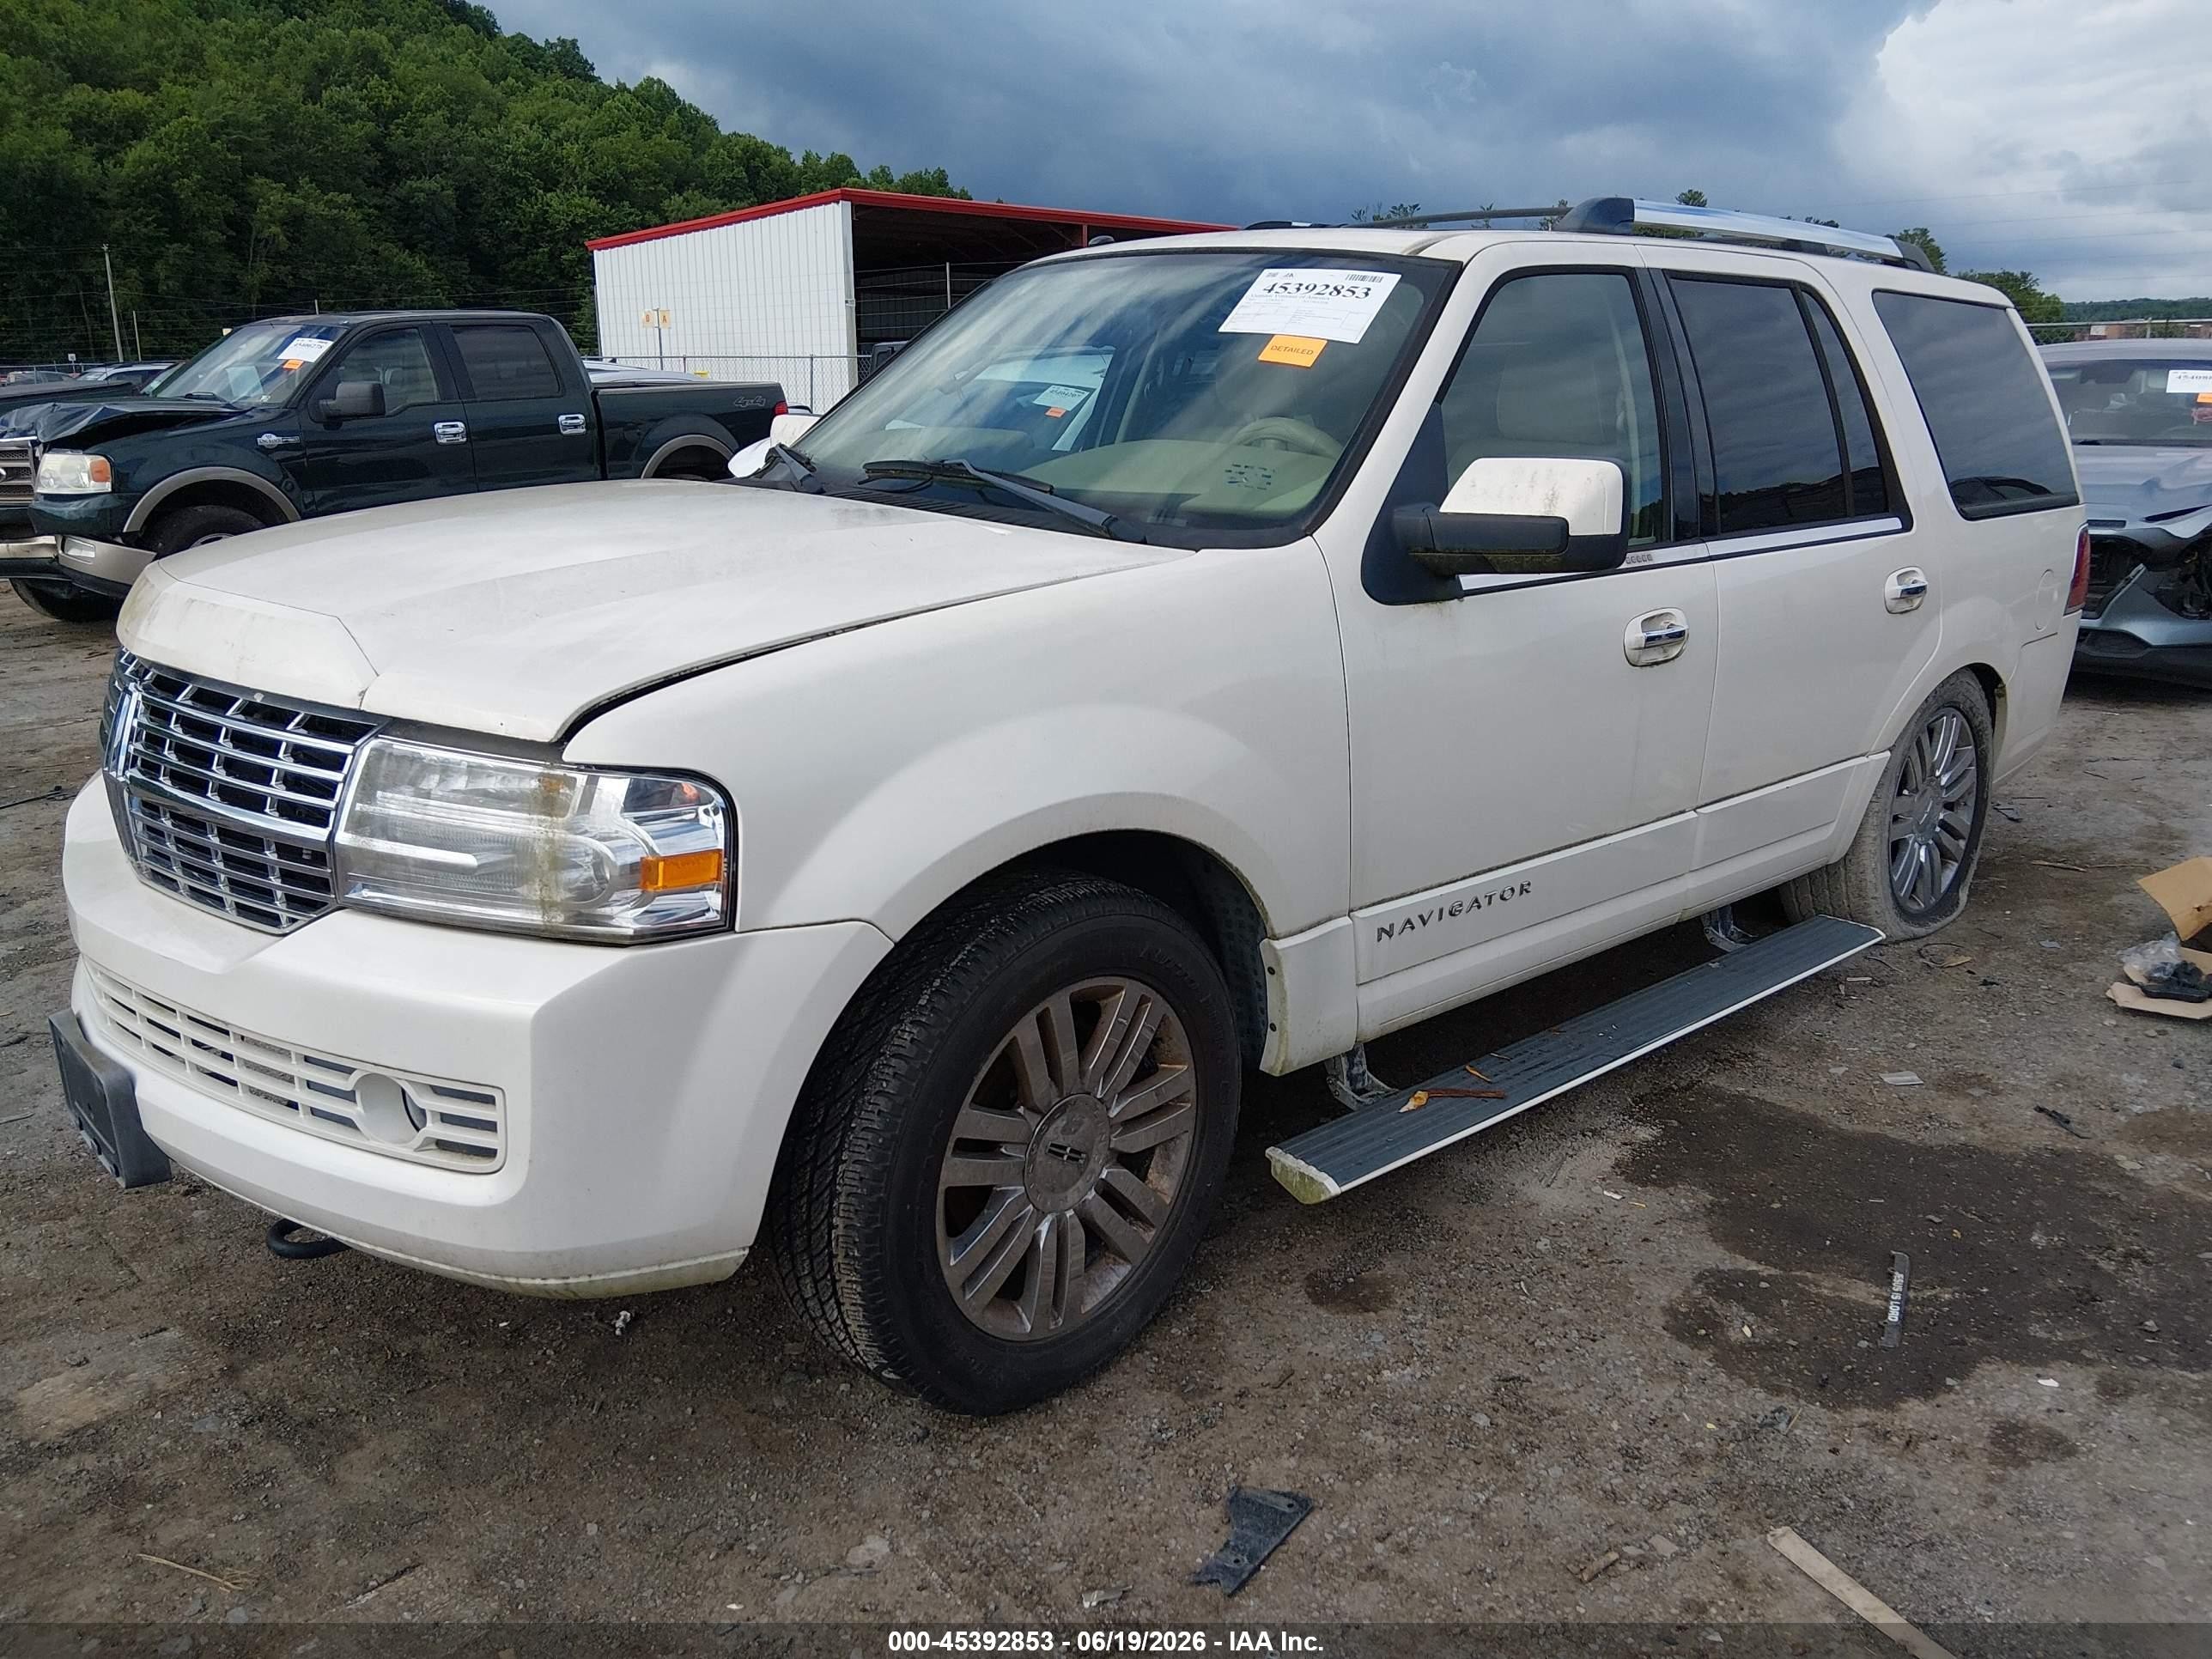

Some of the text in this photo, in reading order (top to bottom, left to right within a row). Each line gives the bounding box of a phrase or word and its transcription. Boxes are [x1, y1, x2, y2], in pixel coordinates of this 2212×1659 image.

[1264, 282, 1371, 299] 45392853
[1270, 345, 1315, 356] DETAILED
[1376, 880, 1532, 942] NAVIGATOR
[1892, 1272, 1904, 1291] JESUS
[1888, 1301, 1900, 1322] LORD
